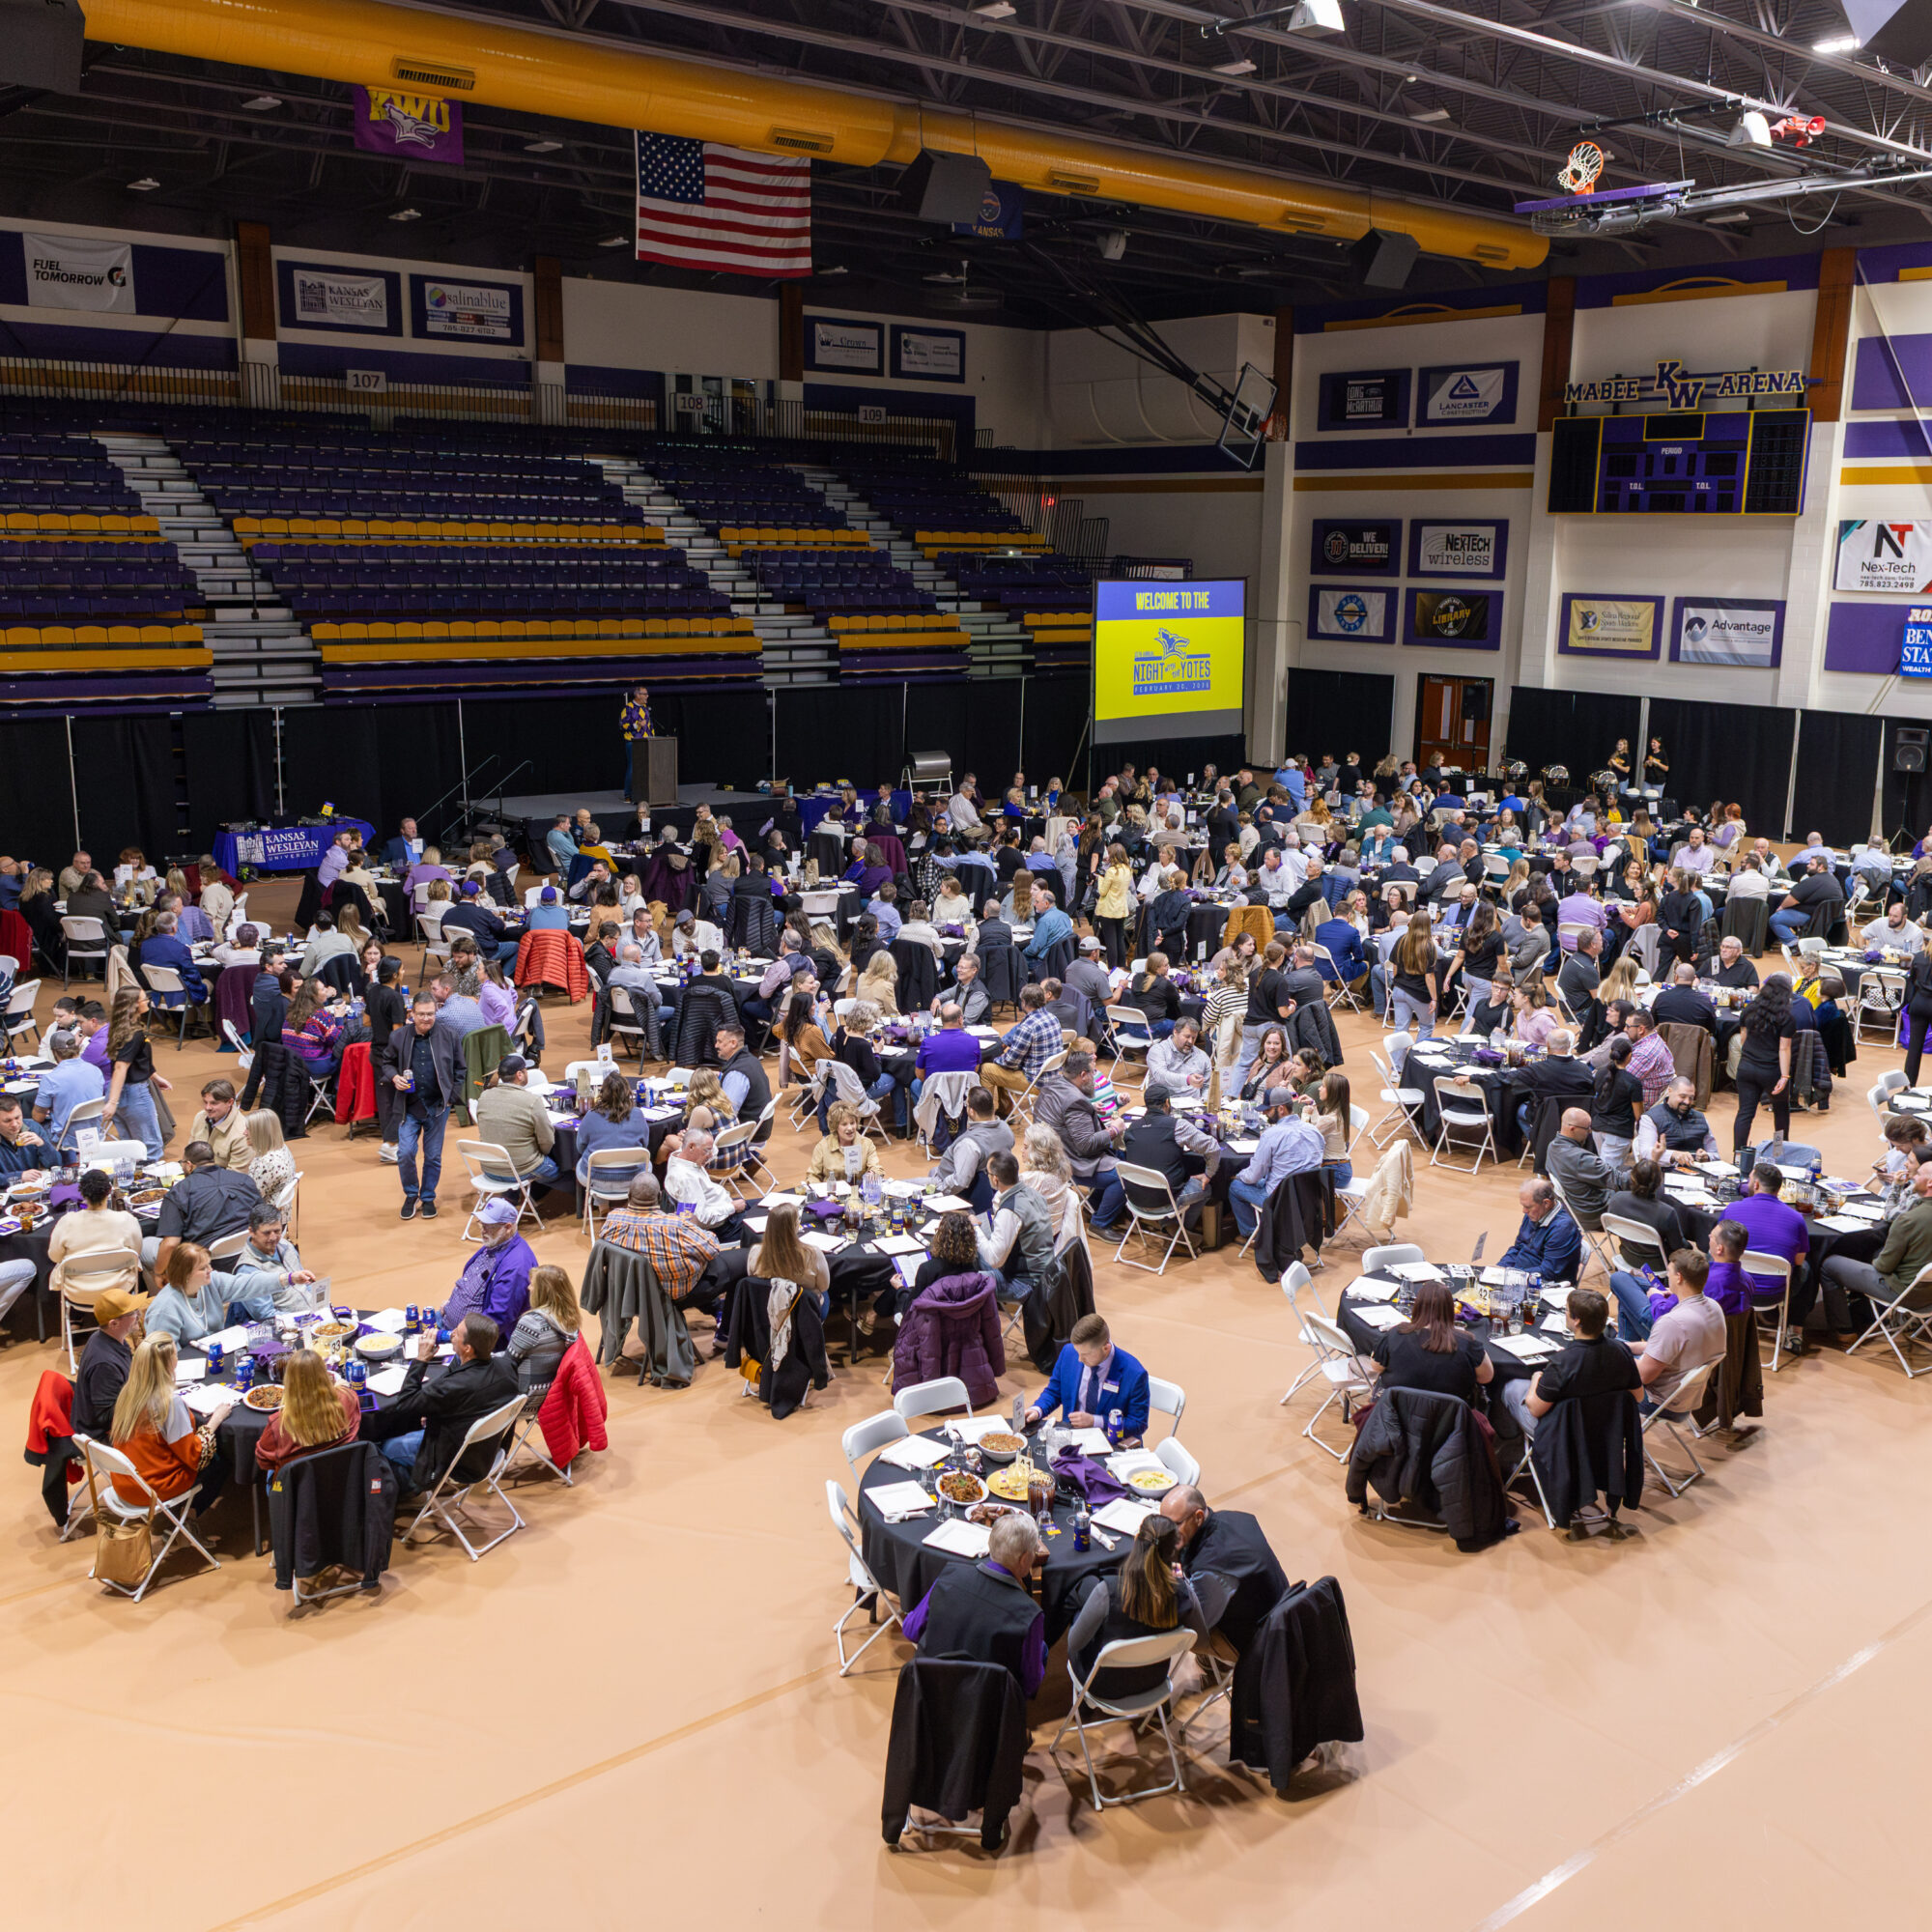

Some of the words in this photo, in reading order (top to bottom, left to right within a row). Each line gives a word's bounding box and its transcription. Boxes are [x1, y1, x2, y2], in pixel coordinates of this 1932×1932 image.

[33, 259, 61, 270] FUEL
[35, 270, 104, 286] TOMORROW
[328, 285, 369, 297] KANSAS
[329, 296, 383, 309] WESLEYAN
[446, 290, 507, 309] salinablue
[352, 373, 380, 388] 107
[1564, 379, 1640, 404] MABEE
[1717, 370, 1804, 397] ARENA
[680, 396, 703, 410] 108
[1439, 401, 1489, 411] LANCASTER
[863, 409, 882, 422] 109
[1362, 531, 1377, 543] WE
[1350, 543, 1389, 554] DELIVER!
[1428, 552, 1490, 566] wireless
[1861, 560, 1916, 574] Nex-Tech
[1859, 580, 1915, 589] 785.823.2498
[1136, 592, 1179, 610] WELCOME
[1180, 591, 1191, 609] TO
[1193, 591, 1209, 609] THE
[1433, 609, 1471, 625] LIBRARY
[1908, 608, 1932, 622] RO
[1712, 619, 1772, 635] Advantage
[1133, 662, 1165, 682] NIGHT
[1180, 660, 1210, 679] YOTES
[1134, 684, 1173, 694] FEBRUARY
[265, 832, 306, 844] KANSAS
[267, 840, 319, 853] WESLEYAN
[1478, 1288, 1488, 1301] 42
[331, 1339, 341, 1354] 33
